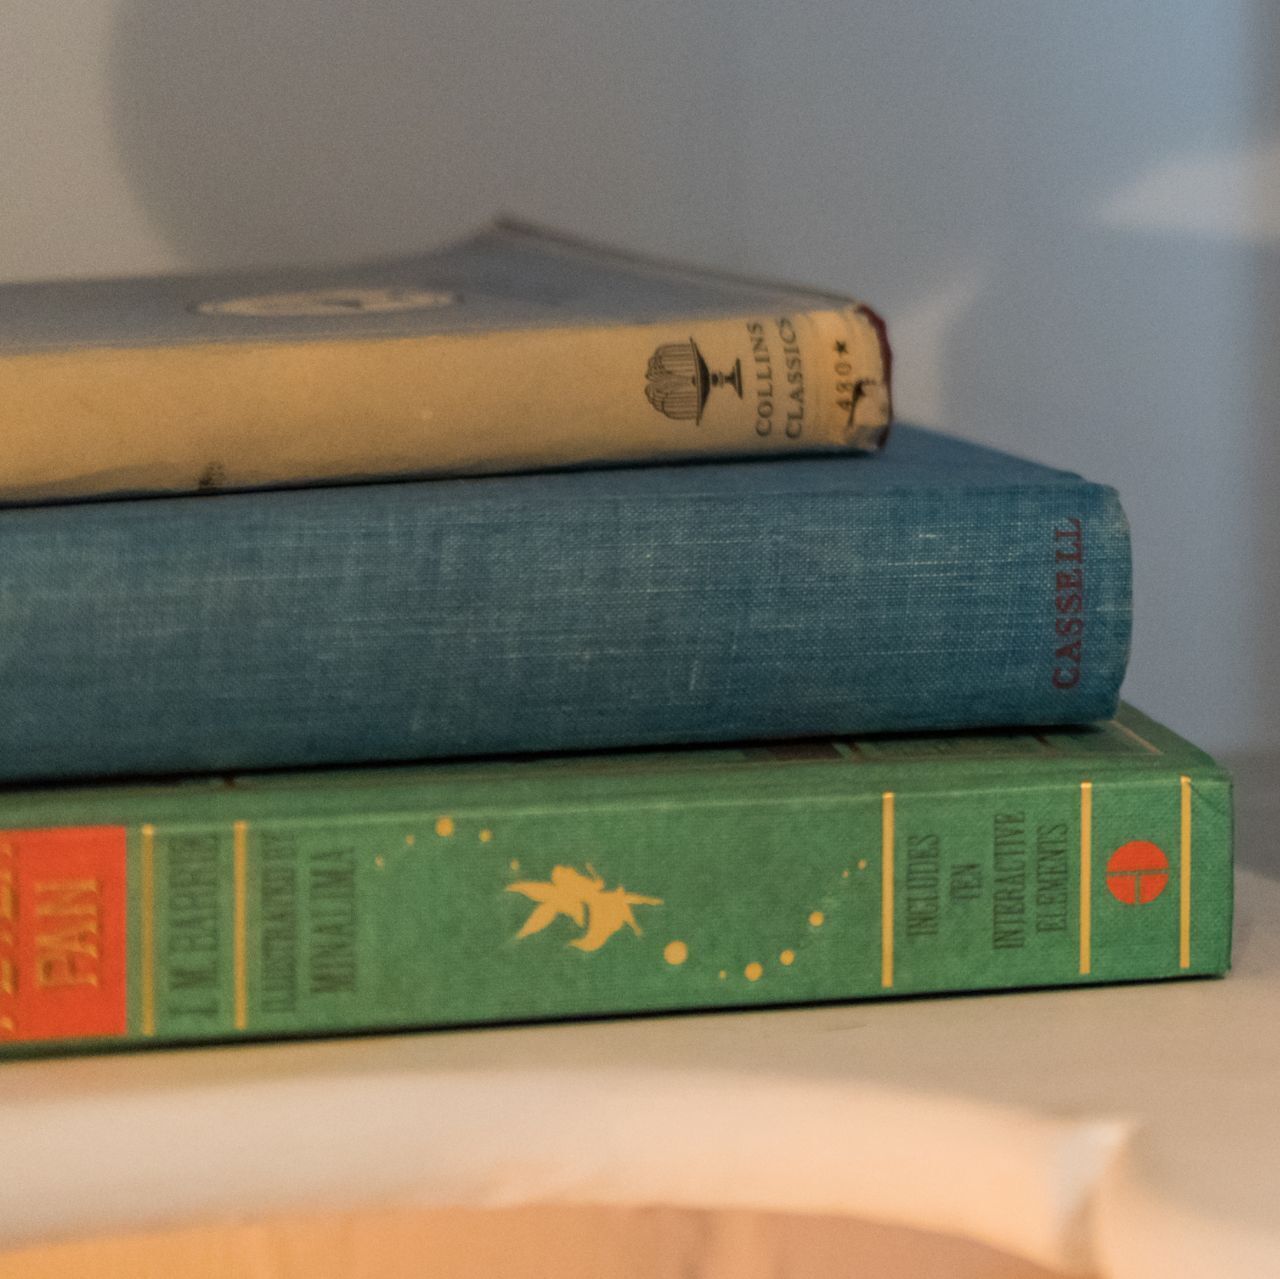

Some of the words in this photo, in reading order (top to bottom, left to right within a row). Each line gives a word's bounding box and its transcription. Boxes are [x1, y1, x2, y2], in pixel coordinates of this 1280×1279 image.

[747, 322, 772, 437] COLLINS
[776, 318, 803, 439] CLASSICS
[1053, 517, 1082, 690] CASSELL
[34, 879, 99, 987] PAN
[907, 833, 940, 936] INCLUDES
[950, 862, 983, 903] TEN
[992, 811, 1026, 949] INTERACTIVE
[1036, 822, 1068, 932] ELEMENTS
